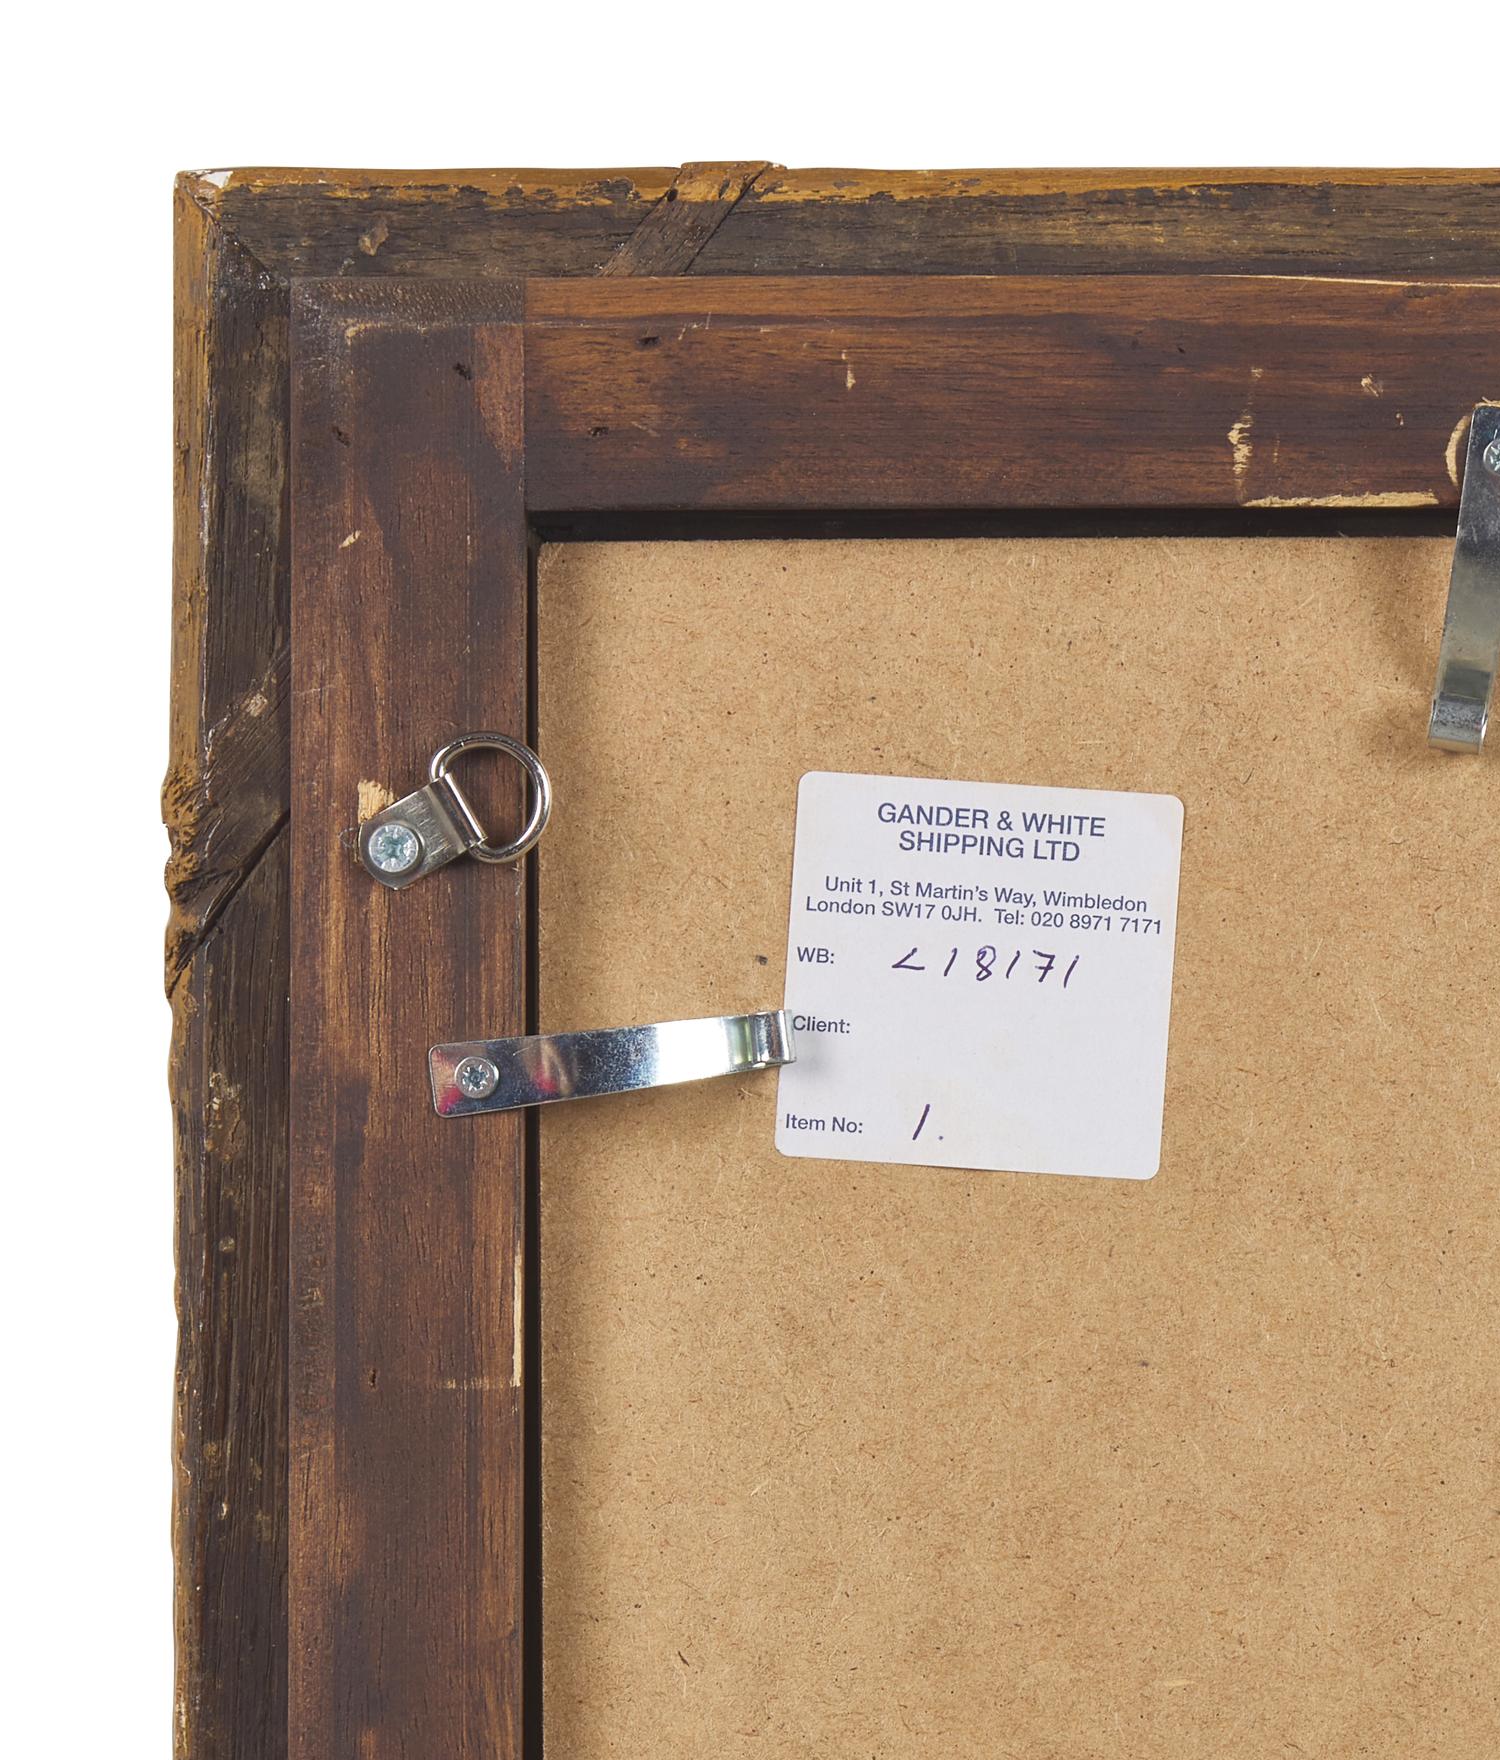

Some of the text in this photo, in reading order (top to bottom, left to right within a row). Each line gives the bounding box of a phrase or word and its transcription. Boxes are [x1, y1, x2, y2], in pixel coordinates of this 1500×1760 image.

[878, 803, 1105, 837] GANDER & WHITE
[899, 831, 1079, 861] SHIPPING LTD
[826, 876, 1146, 912] Unit 1, St Martin's Way, Wimbledon
[807, 896, 1160, 934] London SW17 0JH. Tel: 020 8971 7171
[797, 947, 834, 964] WB:
[793, 1015, 850, 1034] Client:
[786, 1114, 862, 1133] Item No:
